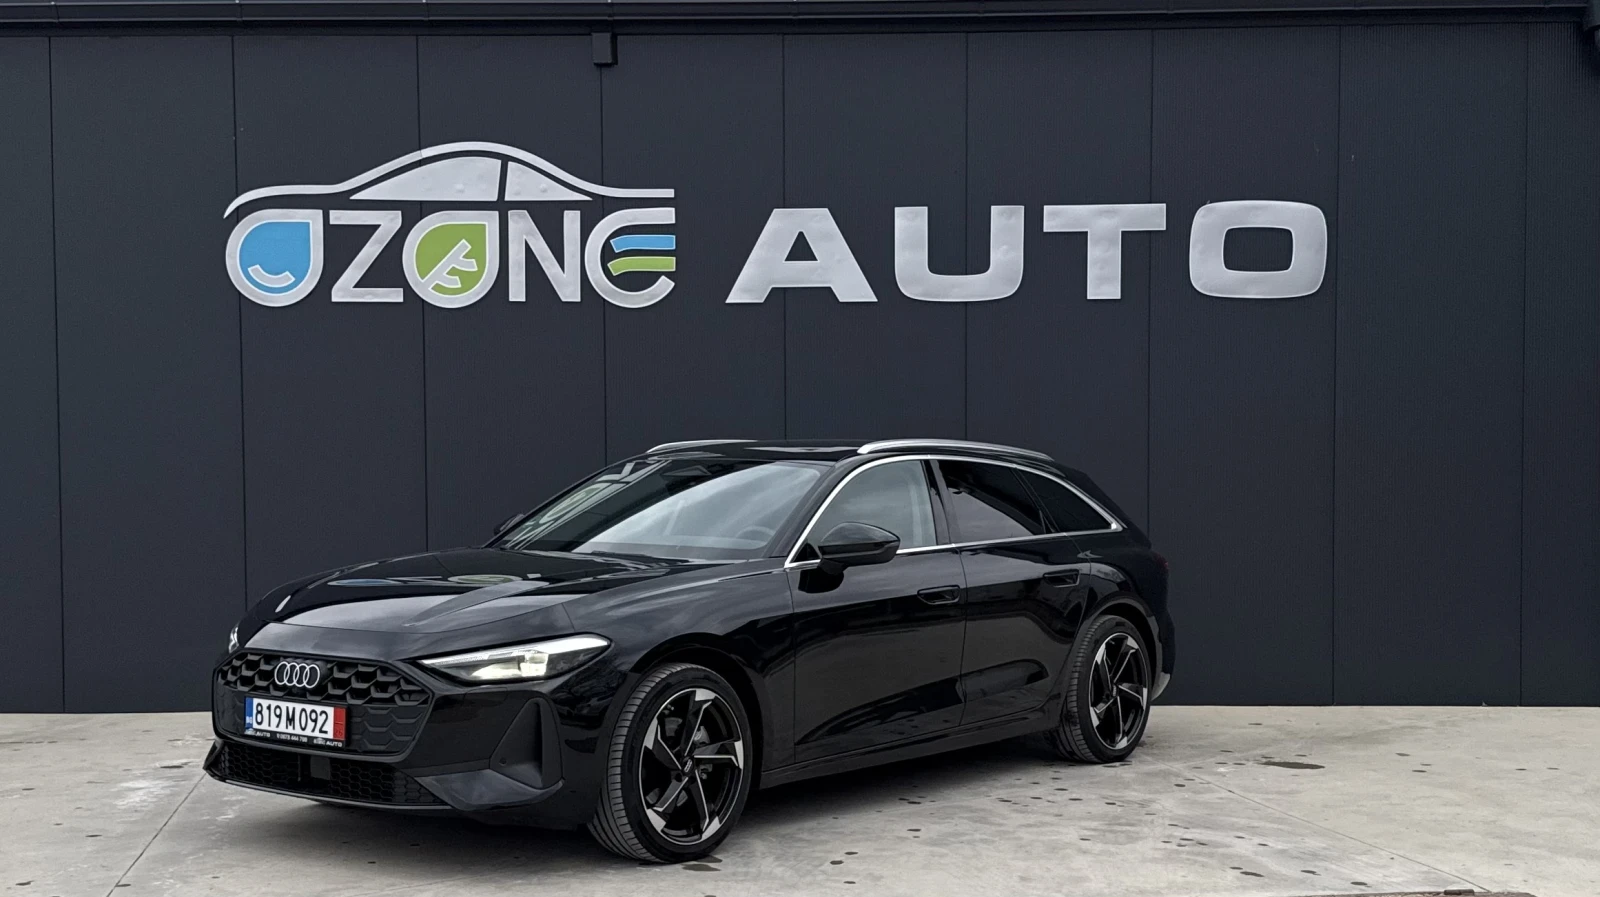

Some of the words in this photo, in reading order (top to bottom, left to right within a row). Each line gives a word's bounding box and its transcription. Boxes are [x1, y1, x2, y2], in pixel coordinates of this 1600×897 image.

[225, 207, 676, 308] OZONE
[725, 200, 1327, 303] AUTO
[255, 702, 329, 734] 819M092
